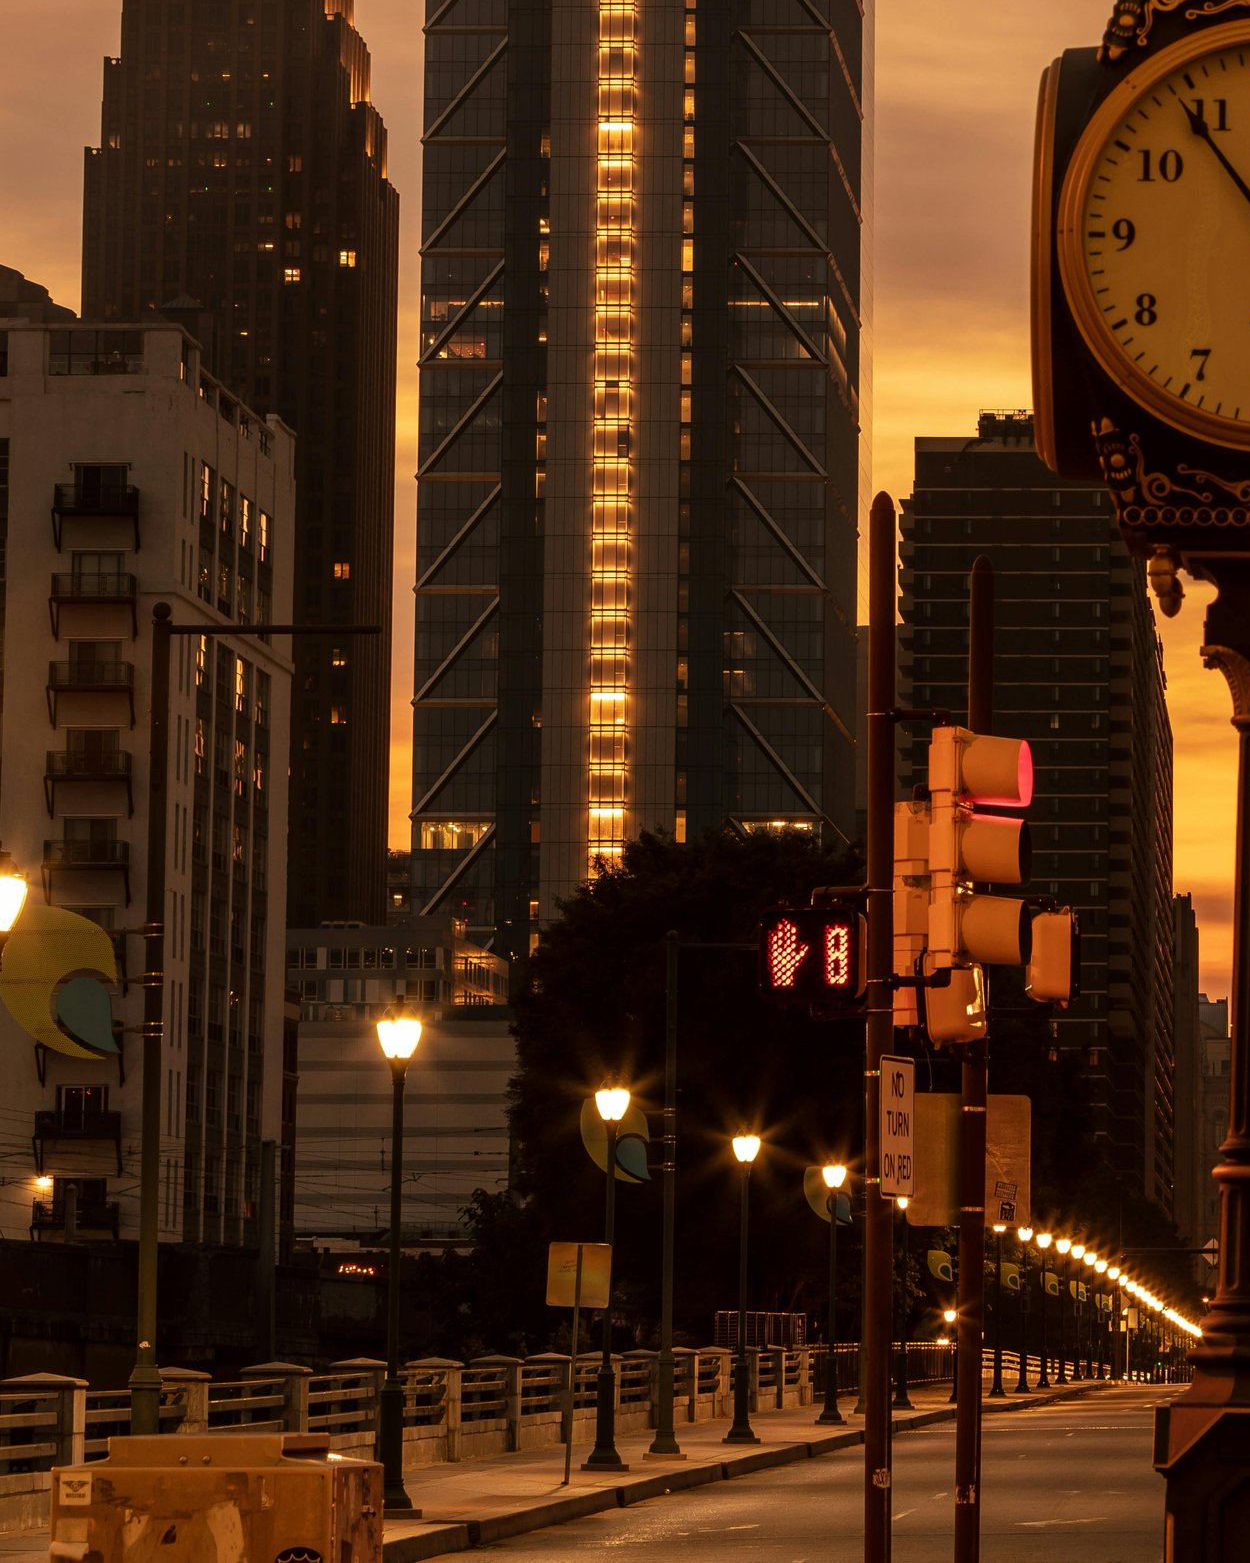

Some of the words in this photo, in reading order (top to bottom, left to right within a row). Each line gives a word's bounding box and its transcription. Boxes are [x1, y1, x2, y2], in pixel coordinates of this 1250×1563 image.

[1191, 99, 1232, 132] 11
[1136, 149, 1184, 183] 10
[1111, 218, 1136, 252] 9
[1134, 293, 1158, 327] 8
[1190, 348, 1212, 381] 7
[826, 925, 848, 985] 8
[891, 1071, 905, 1098] NO
[886, 1110, 910, 1138] TURN
[883, 1153, 895, 1179] ON
[897, 1154, 912, 1181] RED
